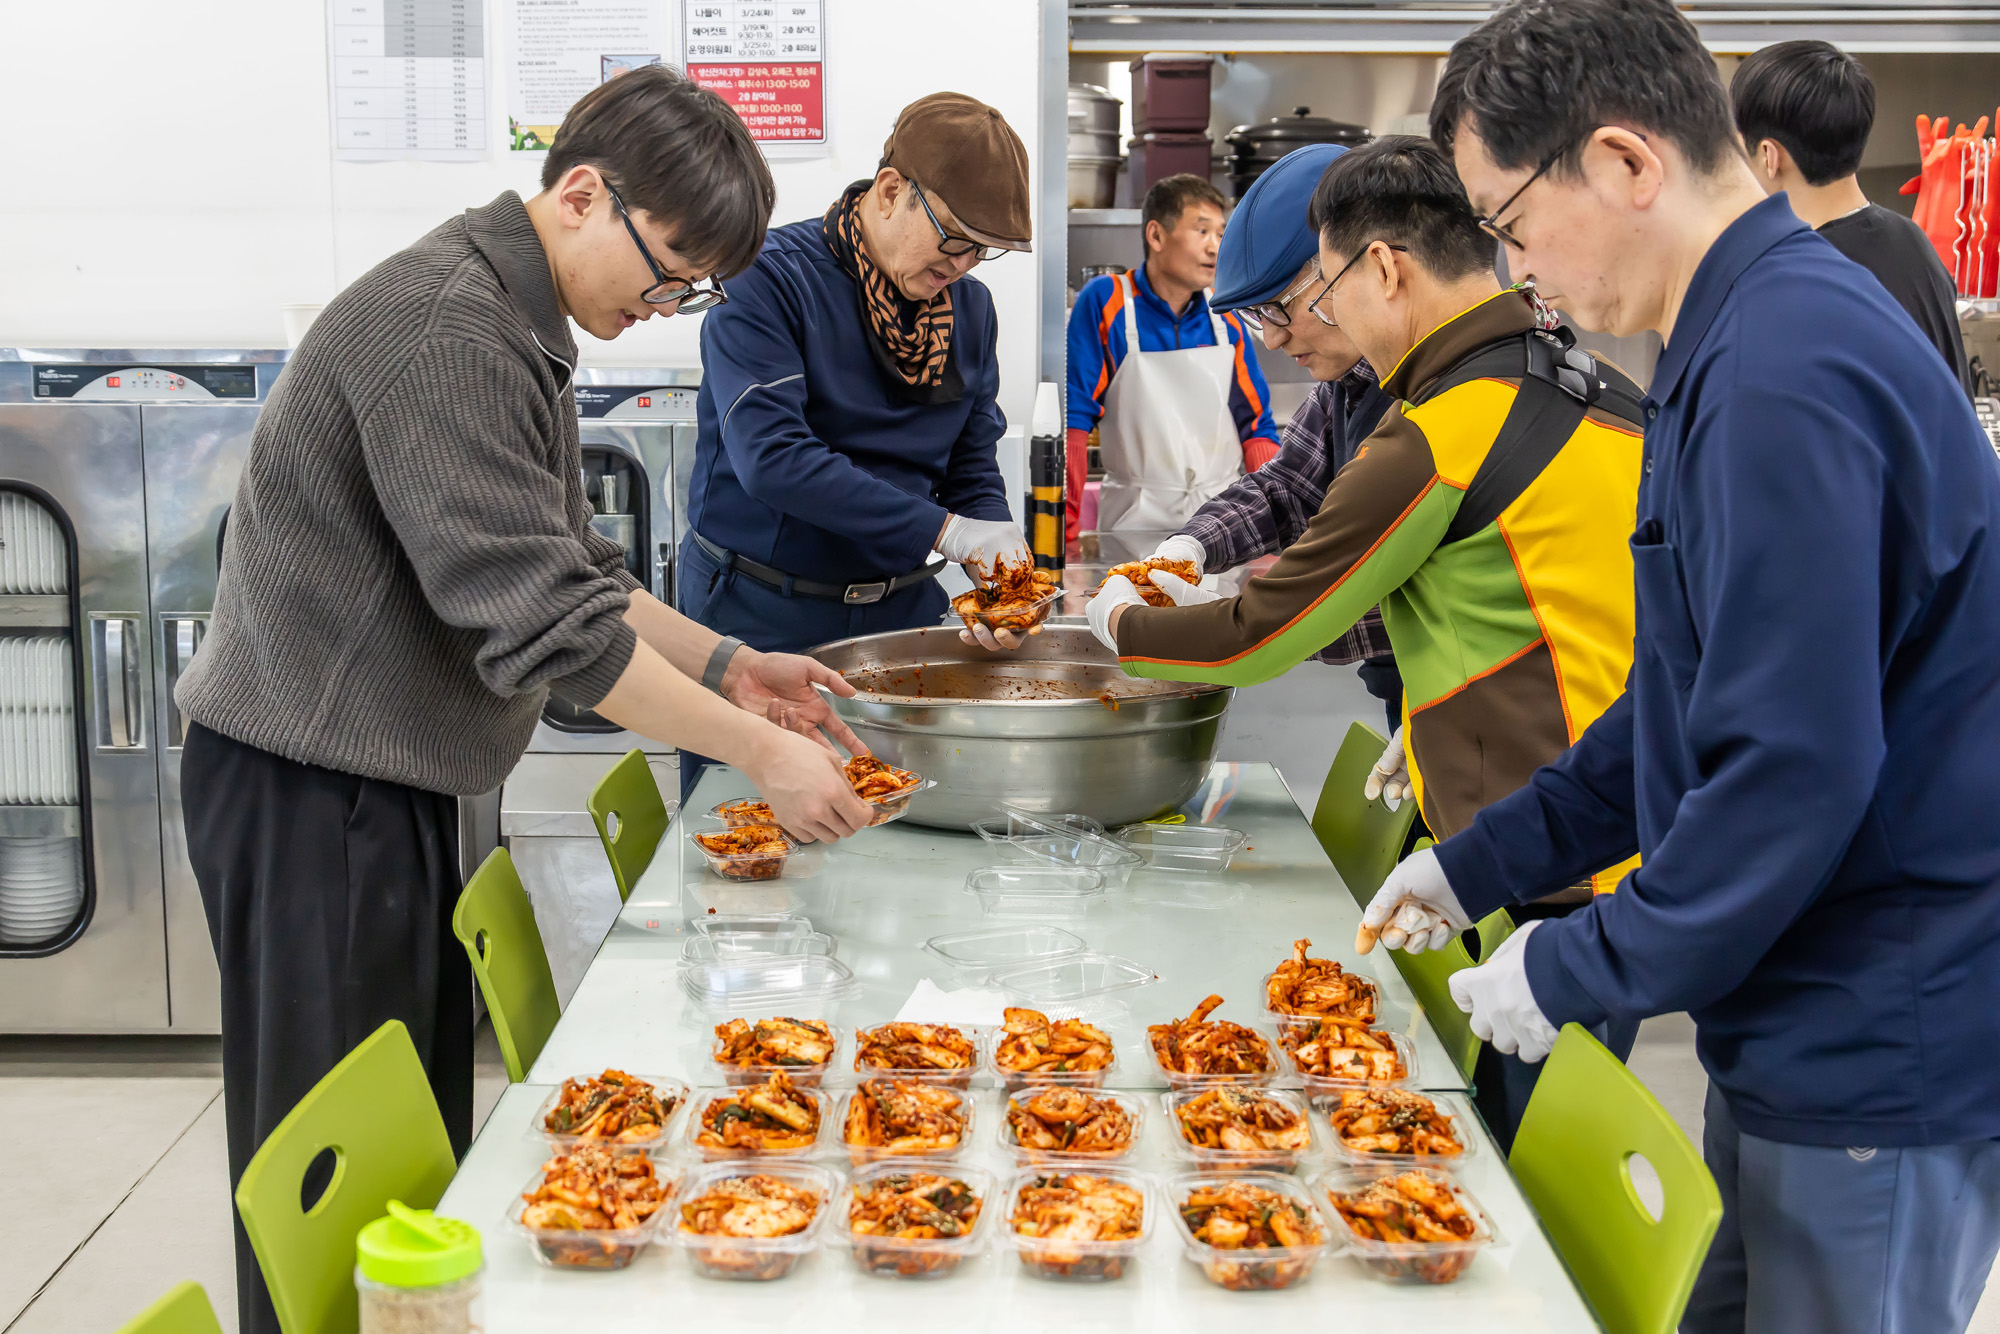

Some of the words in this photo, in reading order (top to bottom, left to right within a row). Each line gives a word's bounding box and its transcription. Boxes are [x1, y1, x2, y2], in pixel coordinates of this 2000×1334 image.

[695, 8, 722, 18] 나들이
[741, 9, 774, 18] 3/24(화)
[791, 8, 806, 16] 외부
[692, 26, 728, 37] 헤어컷트
[782, 26, 794, 34] 2층
[688, 44, 732, 55] 운영위원회
[743, 41, 771, 49] 3/25(수)
[781, 44, 793, 52] 2층
[795, 44, 817, 52] 회의실
[738, 92, 751, 102] 2층
[792, 116, 807, 125] 가능
[807, 127, 822, 137] 가능
[638, 397, 651, 408] 39
